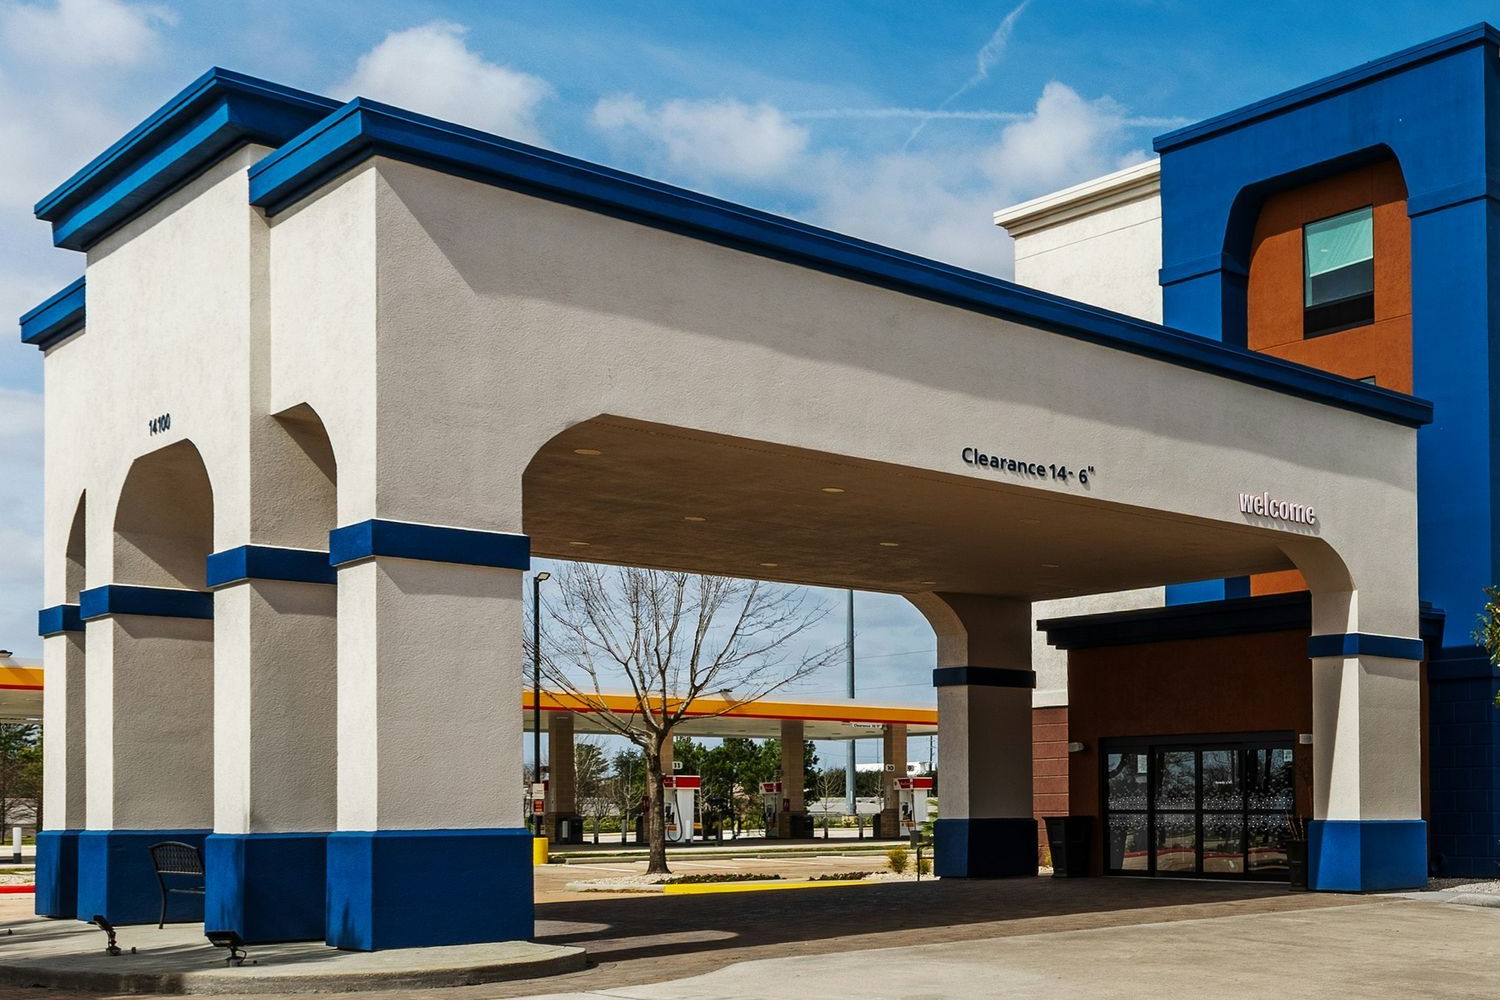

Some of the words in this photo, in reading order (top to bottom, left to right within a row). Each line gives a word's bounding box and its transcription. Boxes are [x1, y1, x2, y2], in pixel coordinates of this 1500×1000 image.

[149, 412, 171, 437] 14100
[961, 446, 1046, 478] Clearance
[1238, 491, 1316, 526] welcome
